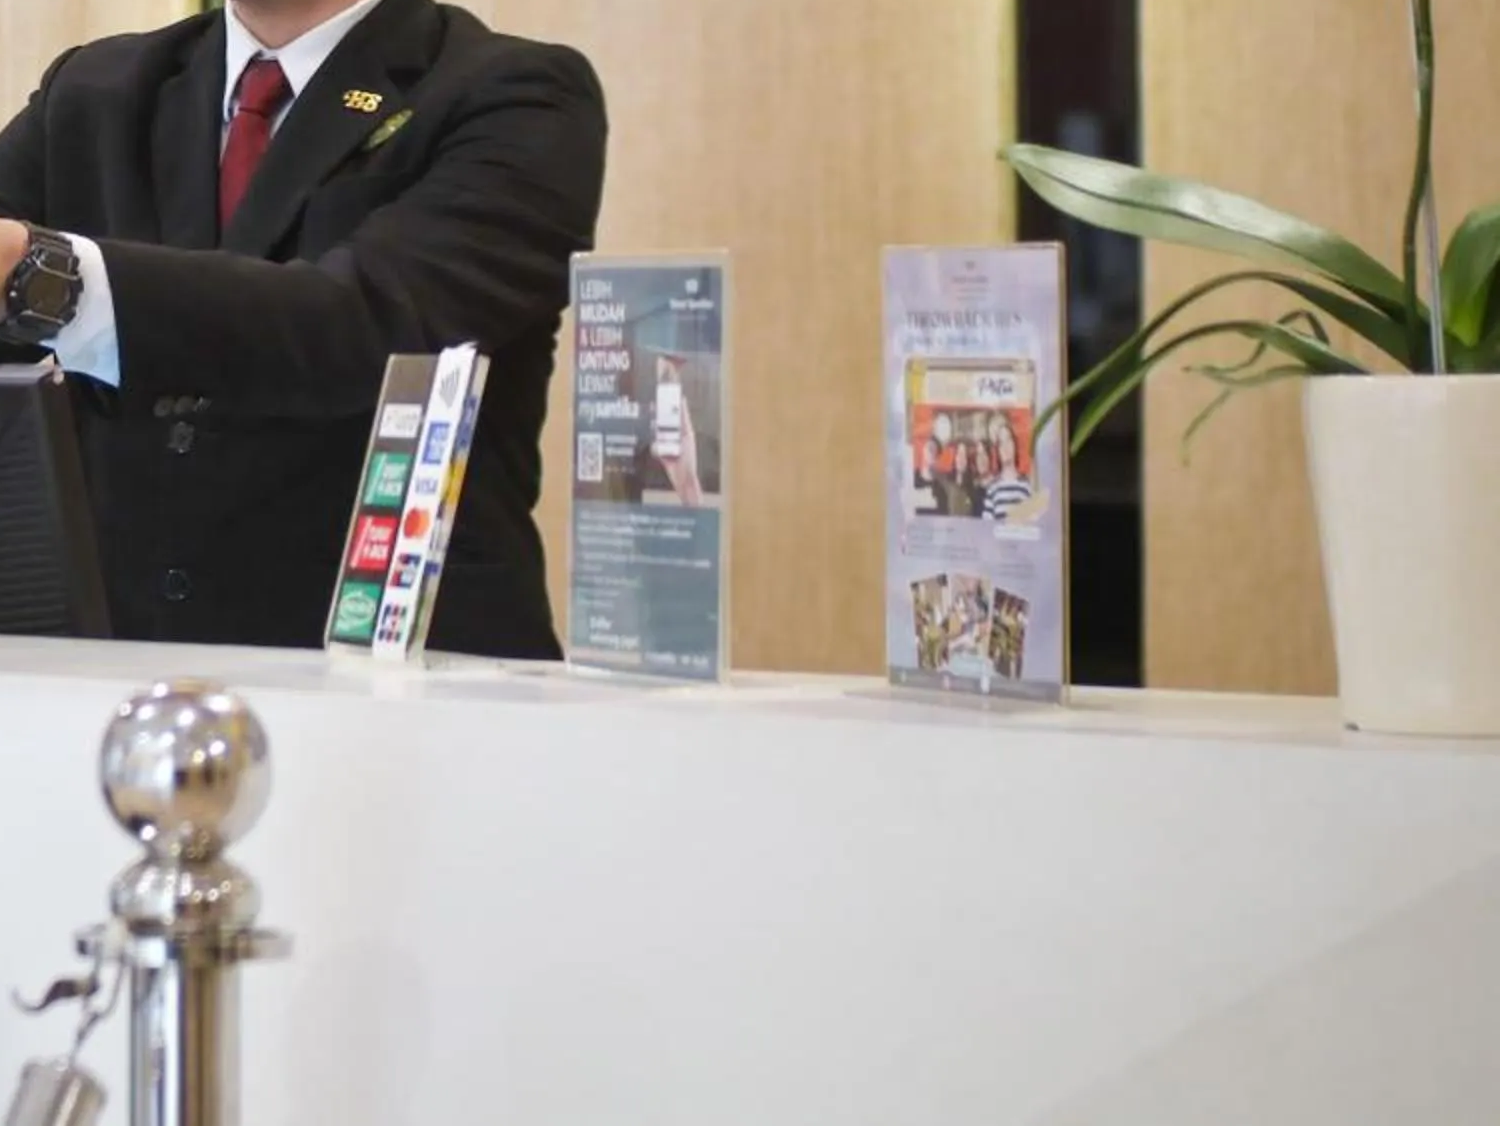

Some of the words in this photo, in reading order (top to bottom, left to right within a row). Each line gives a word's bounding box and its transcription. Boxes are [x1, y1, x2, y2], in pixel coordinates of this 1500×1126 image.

[581, 280, 612, 299] LEBIH
[581, 304, 625, 322] MUDAH
[589, 327, 623, 347] LEBIH
[579, 351, 630, 370] UNTUNG
[578, 375, 616, 394] LEWAT
[415, 478, 438, 494] VISA
